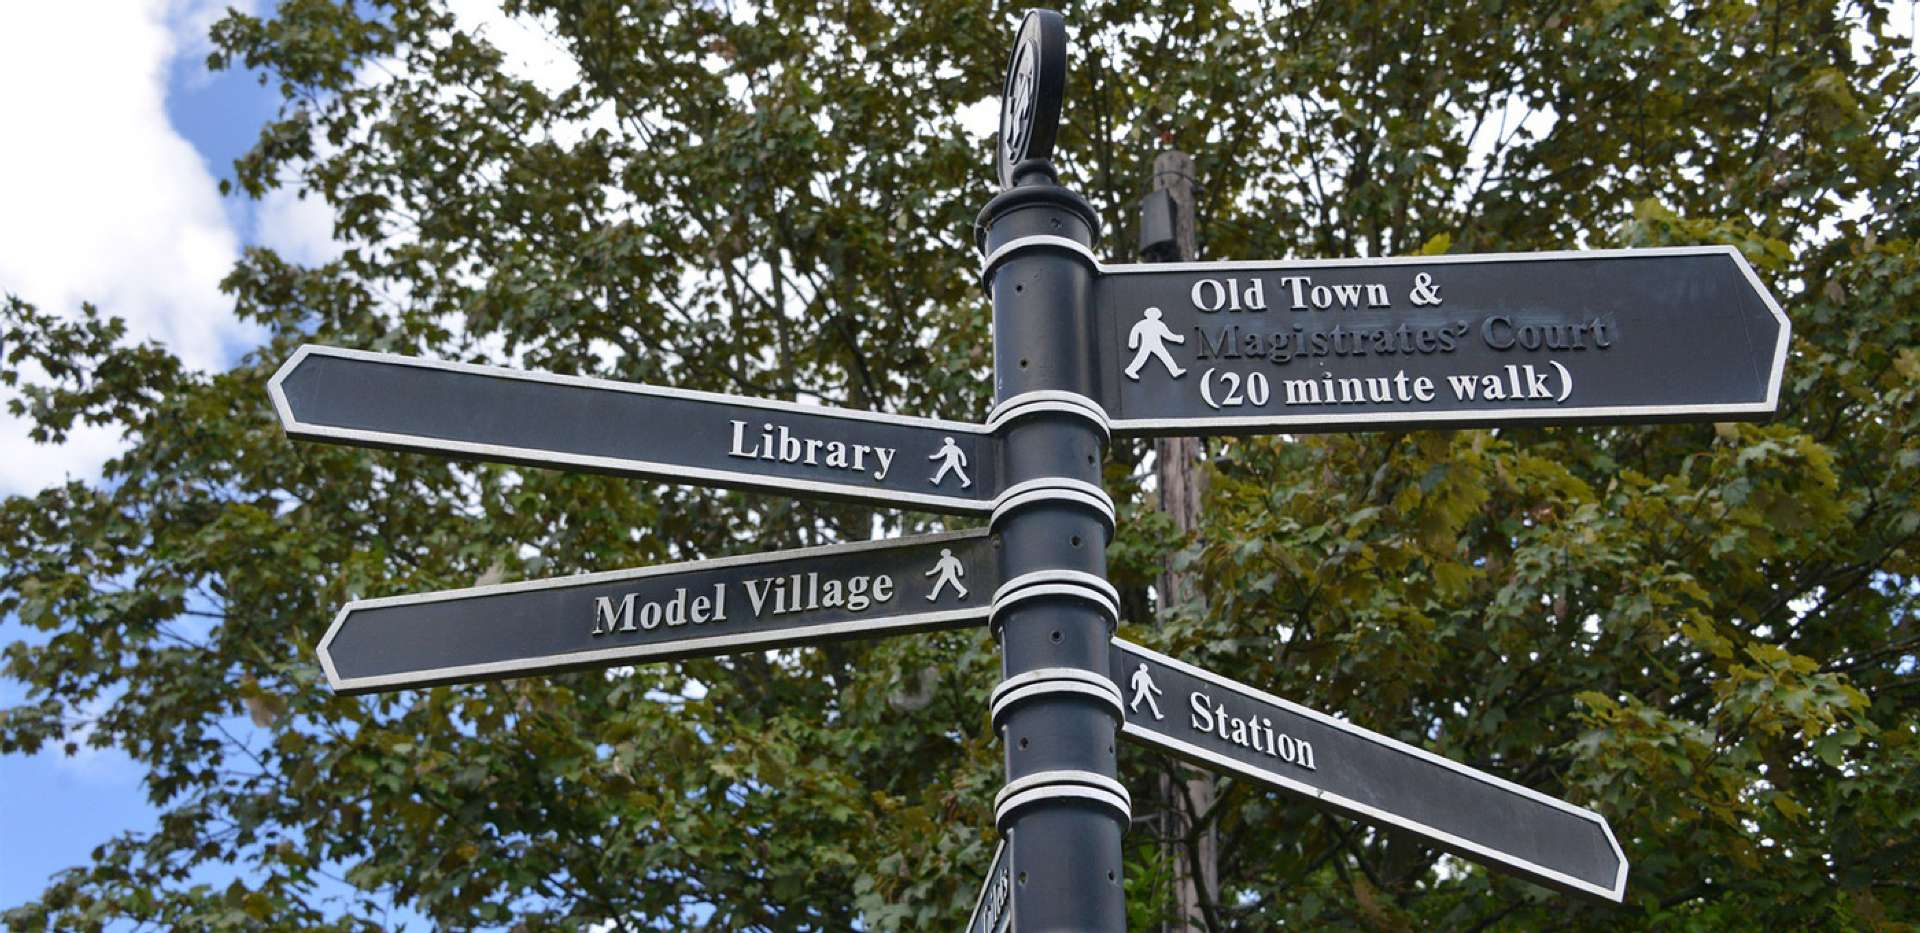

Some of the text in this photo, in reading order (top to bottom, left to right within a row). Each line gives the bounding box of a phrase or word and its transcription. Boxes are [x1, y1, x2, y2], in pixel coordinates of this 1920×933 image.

[1191, 271, 1443, 312] Old Town &
[1482, 316, 1610, 352] Court
[1200, 360, 1573, 409] (20 minute walk)
[728, 420, 896, 480] Library
[592, 571, 893, 635] Model Village
[1190, 691, 1317, 770] Station
